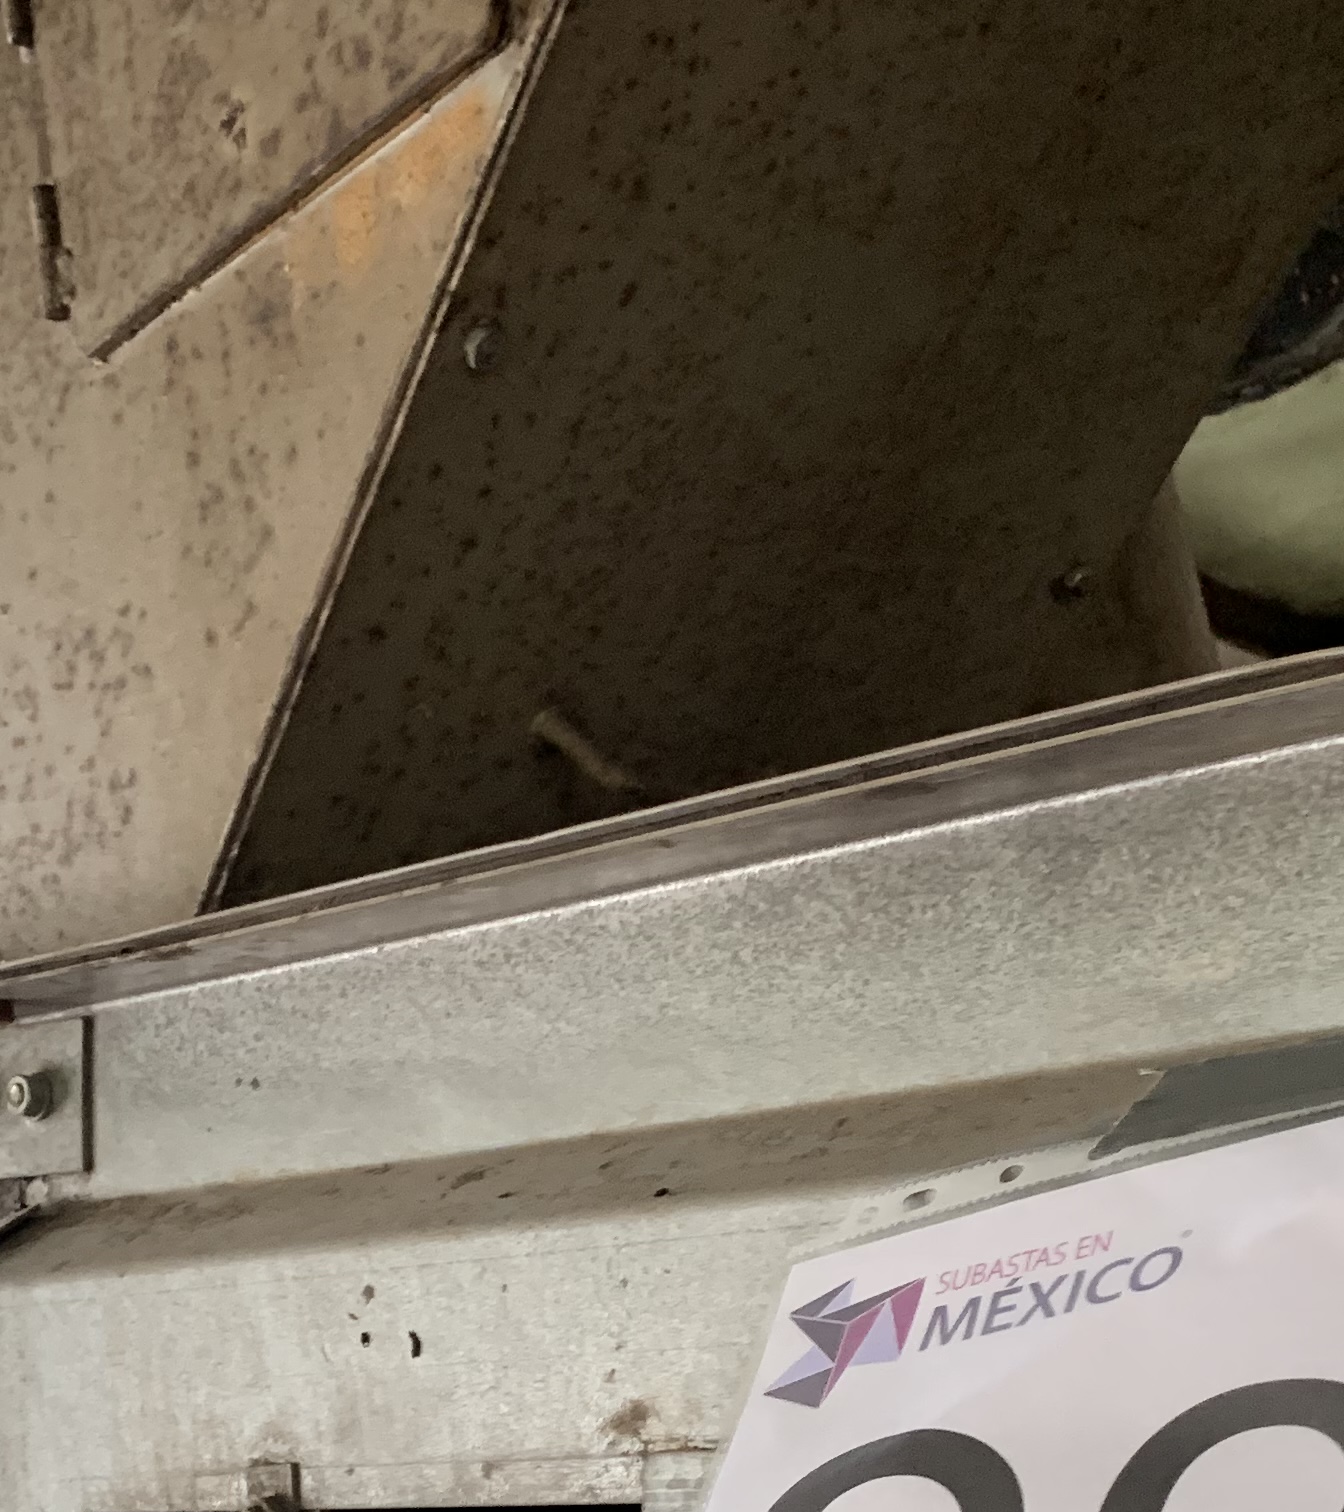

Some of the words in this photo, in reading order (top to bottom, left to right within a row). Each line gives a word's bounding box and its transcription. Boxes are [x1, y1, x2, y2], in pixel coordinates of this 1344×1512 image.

[918, 1245, 1184, 1352] MÉXICO
[935, 1241, 1068, 1296] SUBASTAS
[1075, 1229, 1116, 1261] EN
